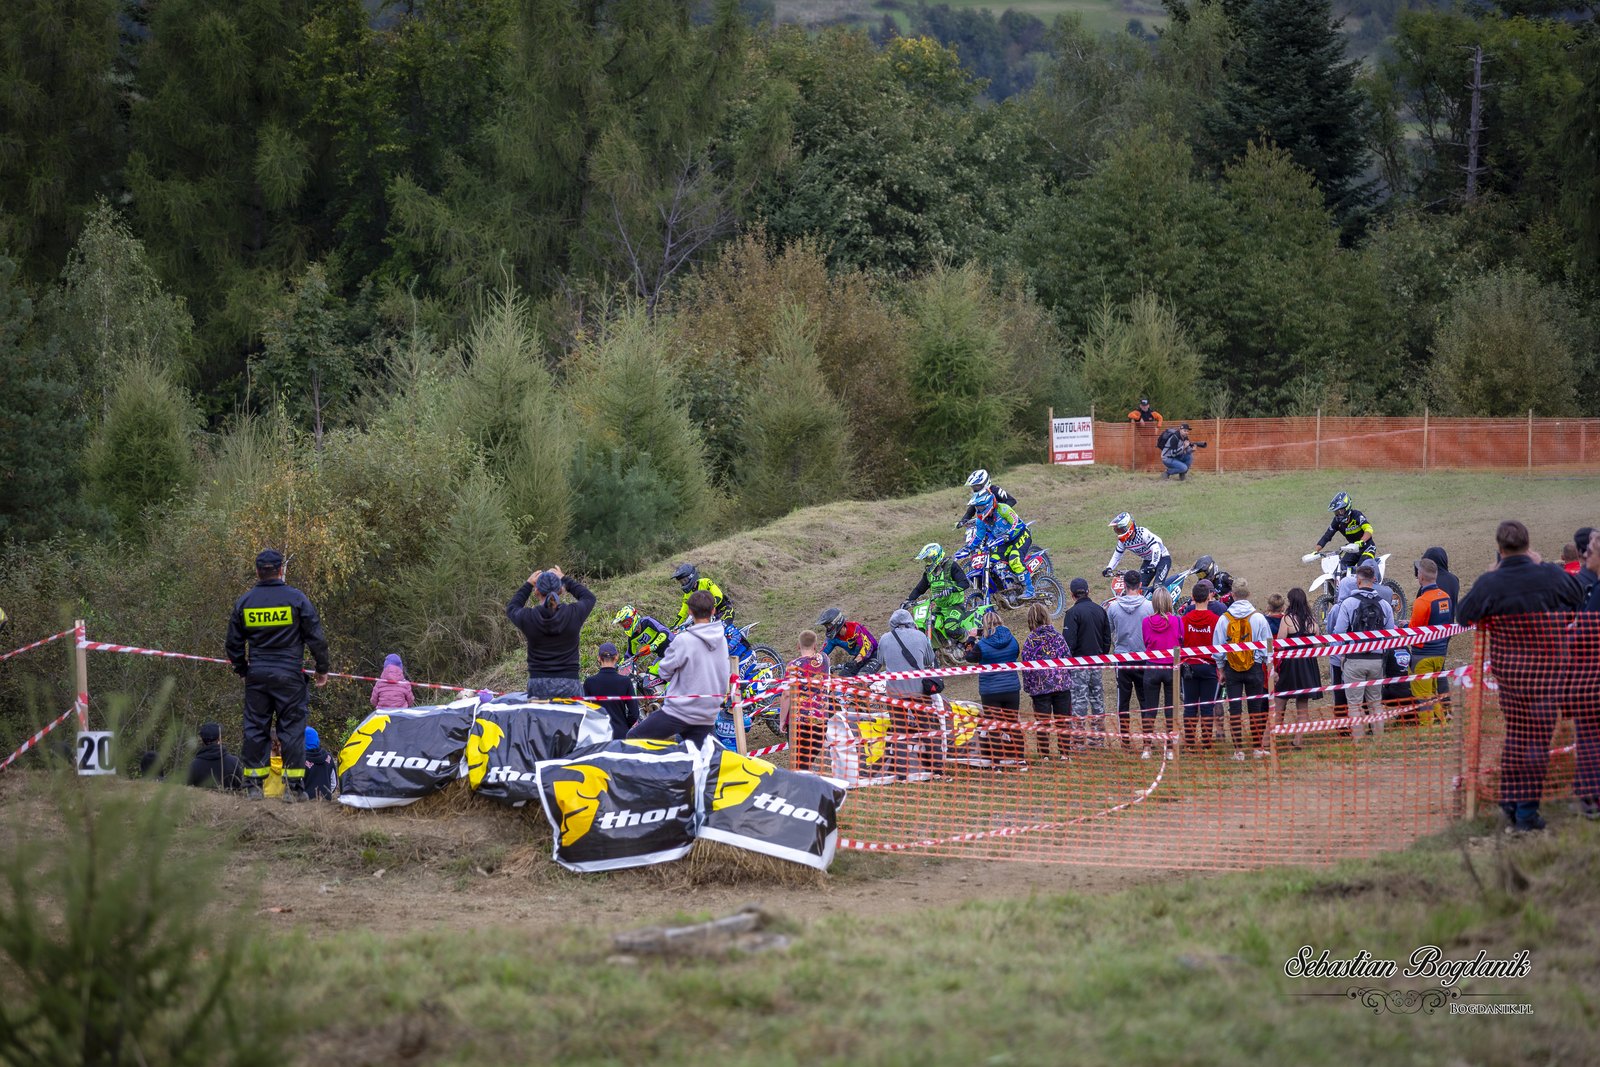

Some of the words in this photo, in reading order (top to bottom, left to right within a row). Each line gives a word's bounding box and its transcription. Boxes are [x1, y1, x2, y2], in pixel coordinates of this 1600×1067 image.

[1054, 421, 1091, 434] MOTOLARK
[77, 735, 115, 771] 20
[365, 751, 451, 773] thor
[598, 803, 690, 831] thor
